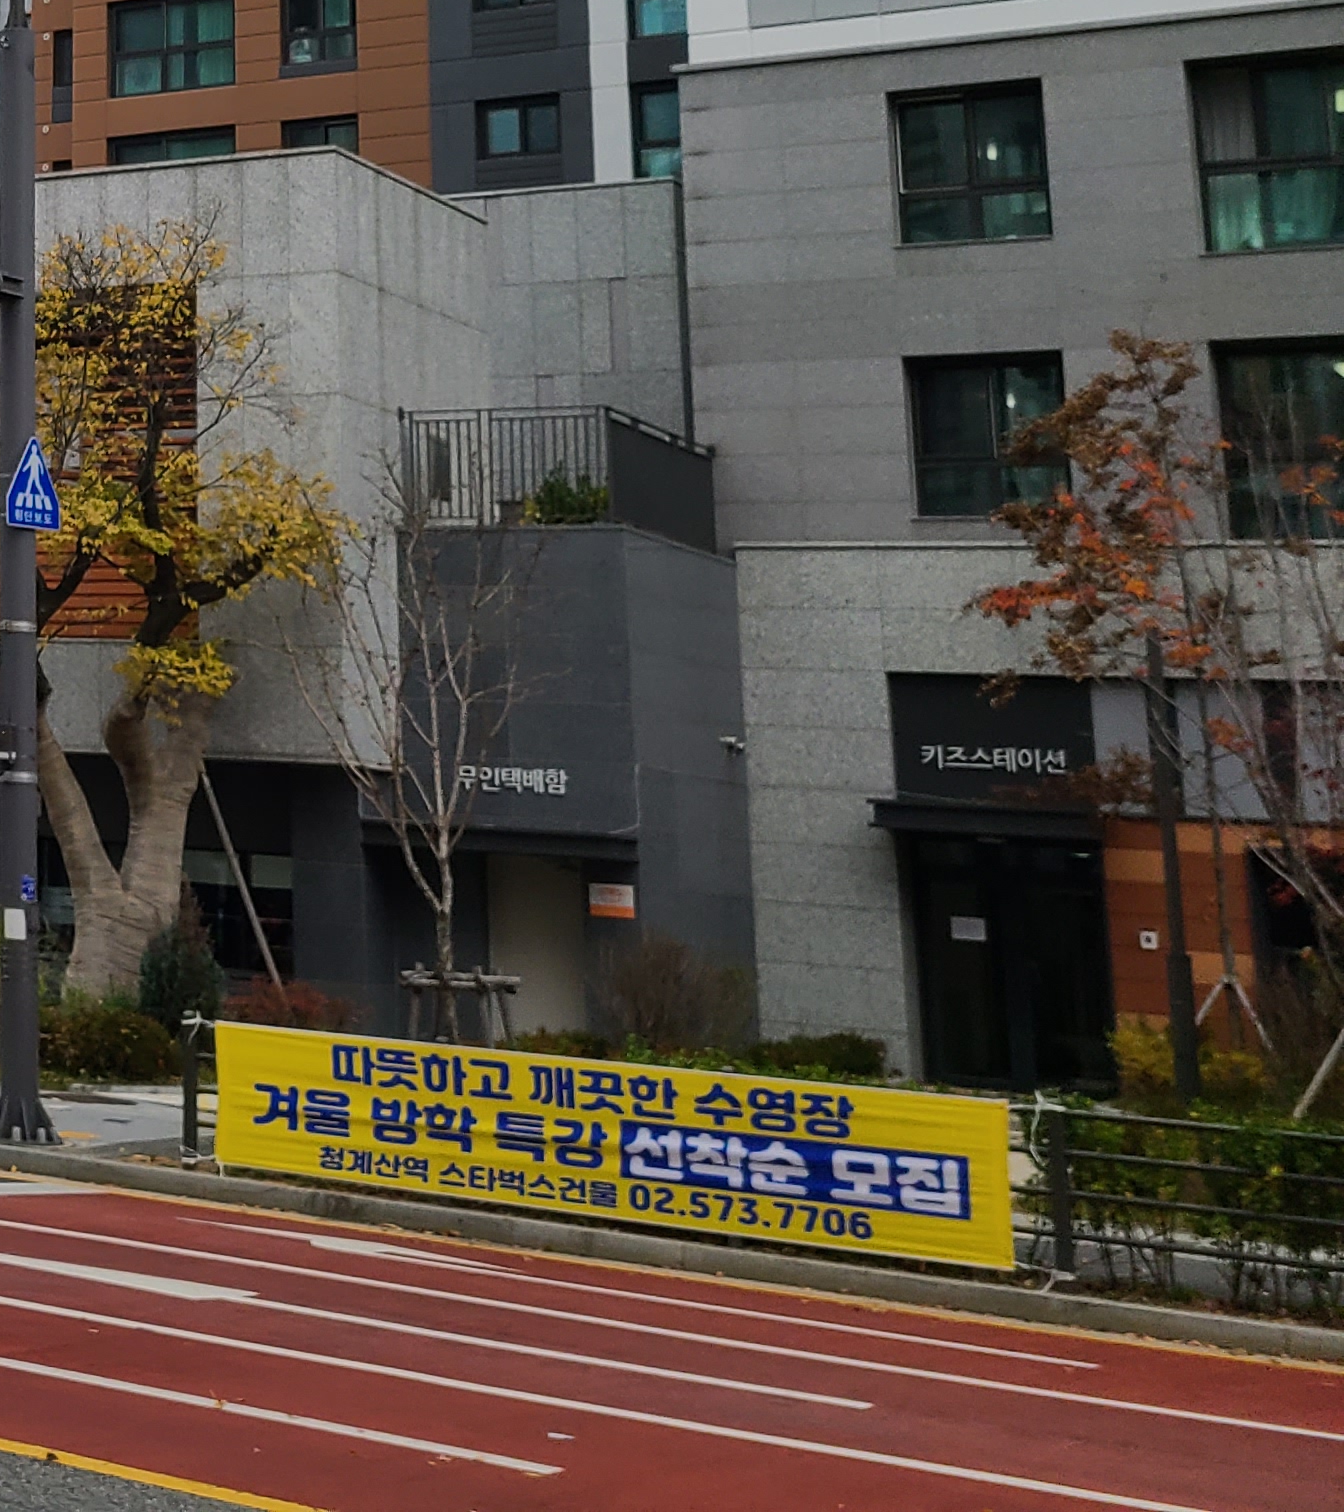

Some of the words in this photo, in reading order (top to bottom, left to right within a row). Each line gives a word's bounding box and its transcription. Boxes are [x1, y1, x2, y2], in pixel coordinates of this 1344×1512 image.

[15, 508, 53, 524] 횡단보도
[458, 765, 569, 795] 무인택배함
[920, 744, 1068, 774] 키즈스테이션
[331, 1043, 514, 1101] 따뜻하고
[528, 1065, 679, 1120] 깨끗한
[694, 1082, 855, 1139] 수영장
[252, 1082, 352, 1138] 겨울
[370, 1096, 478, 1153] 방학
[493, 1111, 608, 1170] 특강
[623, 1126, 810, 1195] 선착순
[828, 1148, 964, 1217] 모집
[318, 1145, 429, 1183] 청계산역
[438, 1162, 618, 1209] 스타벅스건물
[627, 1184, 874, 1240] 02.573.7706
